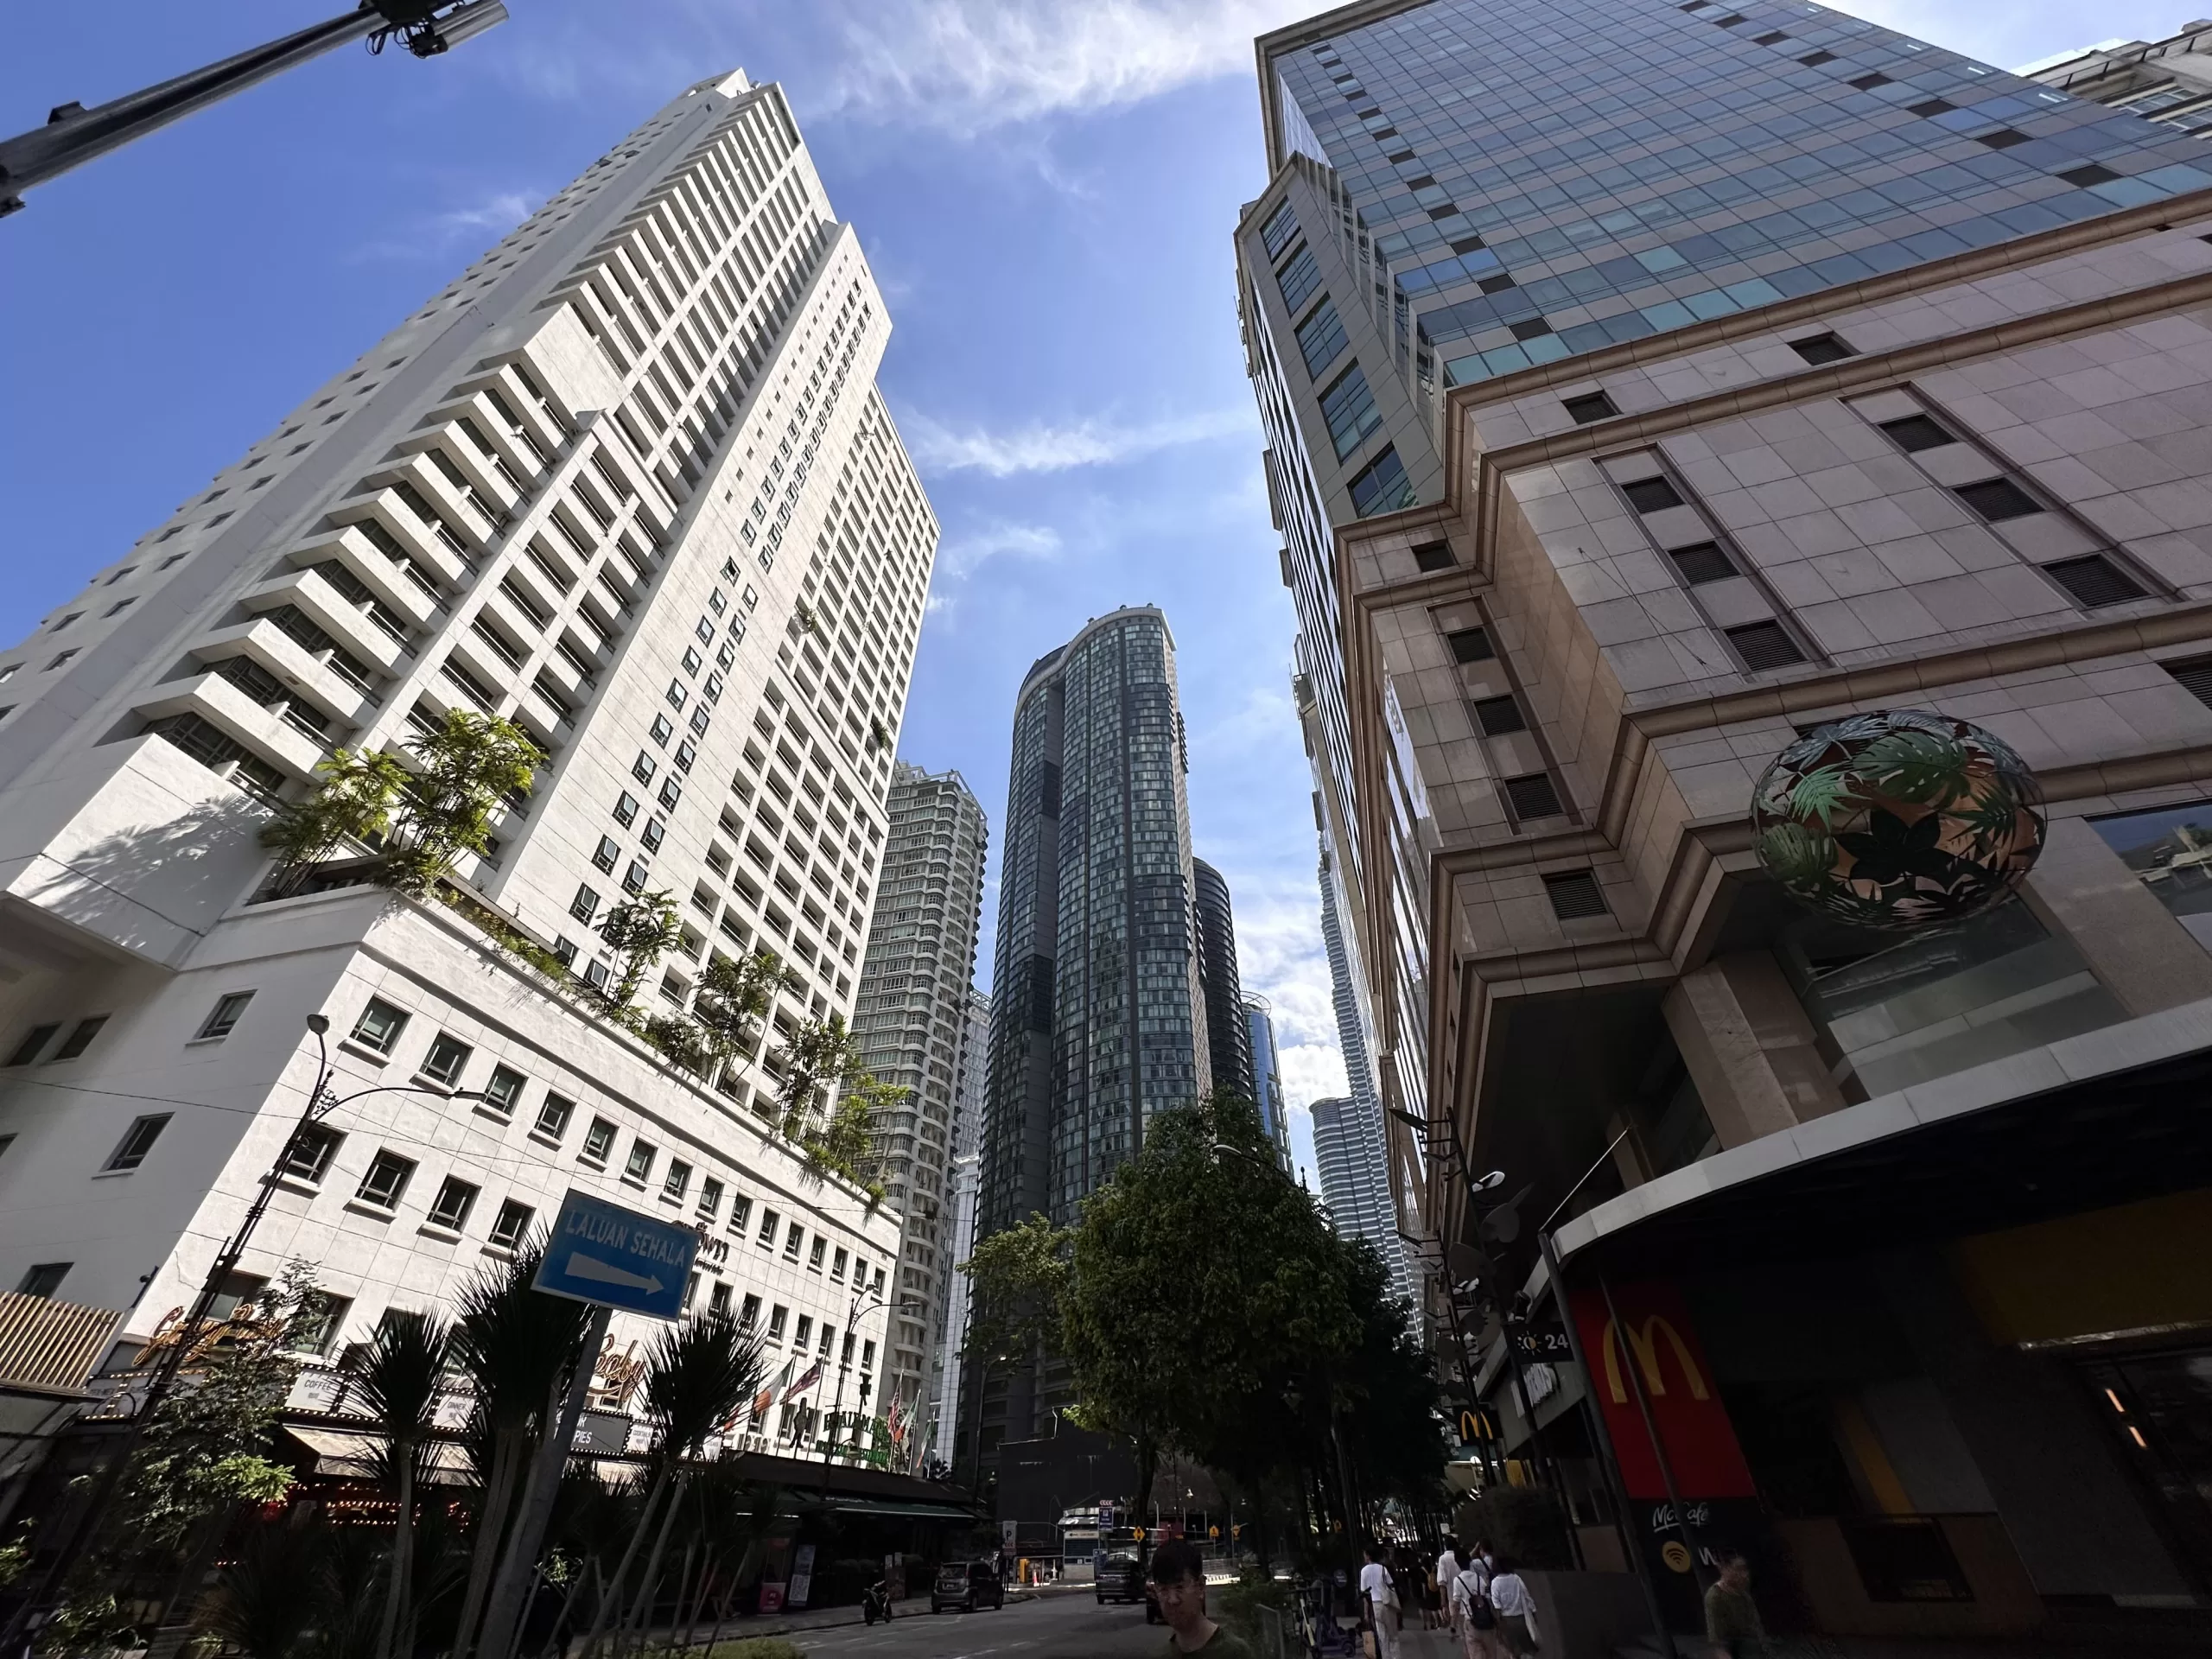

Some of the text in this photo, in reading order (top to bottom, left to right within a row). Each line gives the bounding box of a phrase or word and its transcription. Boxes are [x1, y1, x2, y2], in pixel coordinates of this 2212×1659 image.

[565, 1211, 629, 1249] LALUAN
[630, 1230, 685, 1268] SEHALA
[1545, 1334, 1568, 1350] 24
[304, 1379, 331, 1391] COFFEE
[1652, 1501, 1711, 1532] Mcafé
